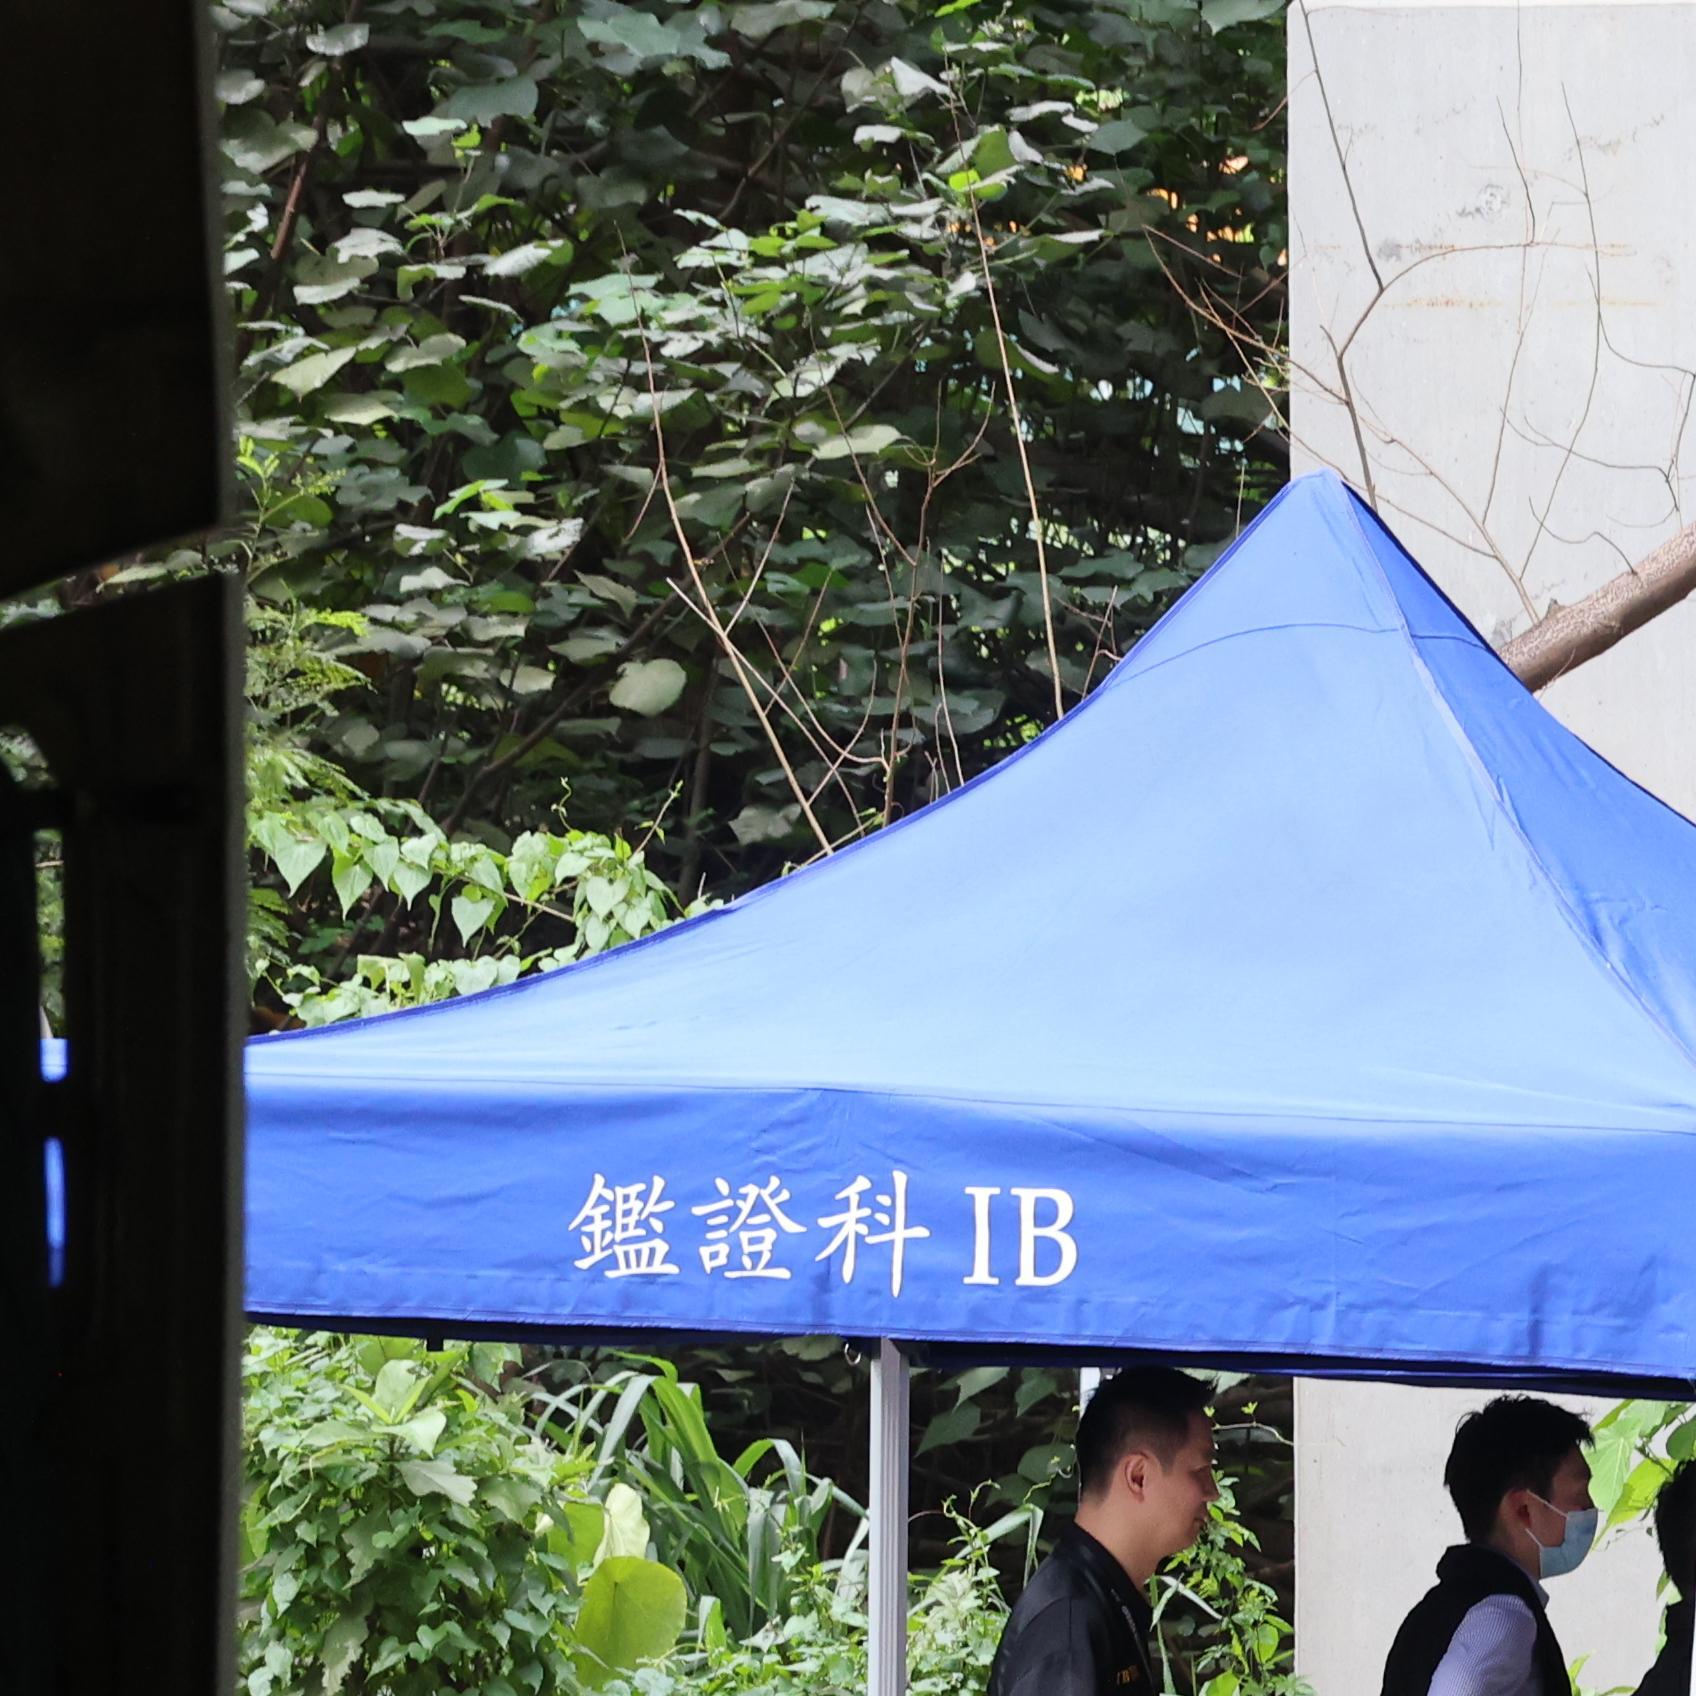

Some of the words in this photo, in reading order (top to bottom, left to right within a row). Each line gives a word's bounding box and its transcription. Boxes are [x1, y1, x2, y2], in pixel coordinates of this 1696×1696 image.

[568, 1170, 931, 1298] 鑑證科
[962, 1186, 1078, 1288] IB
